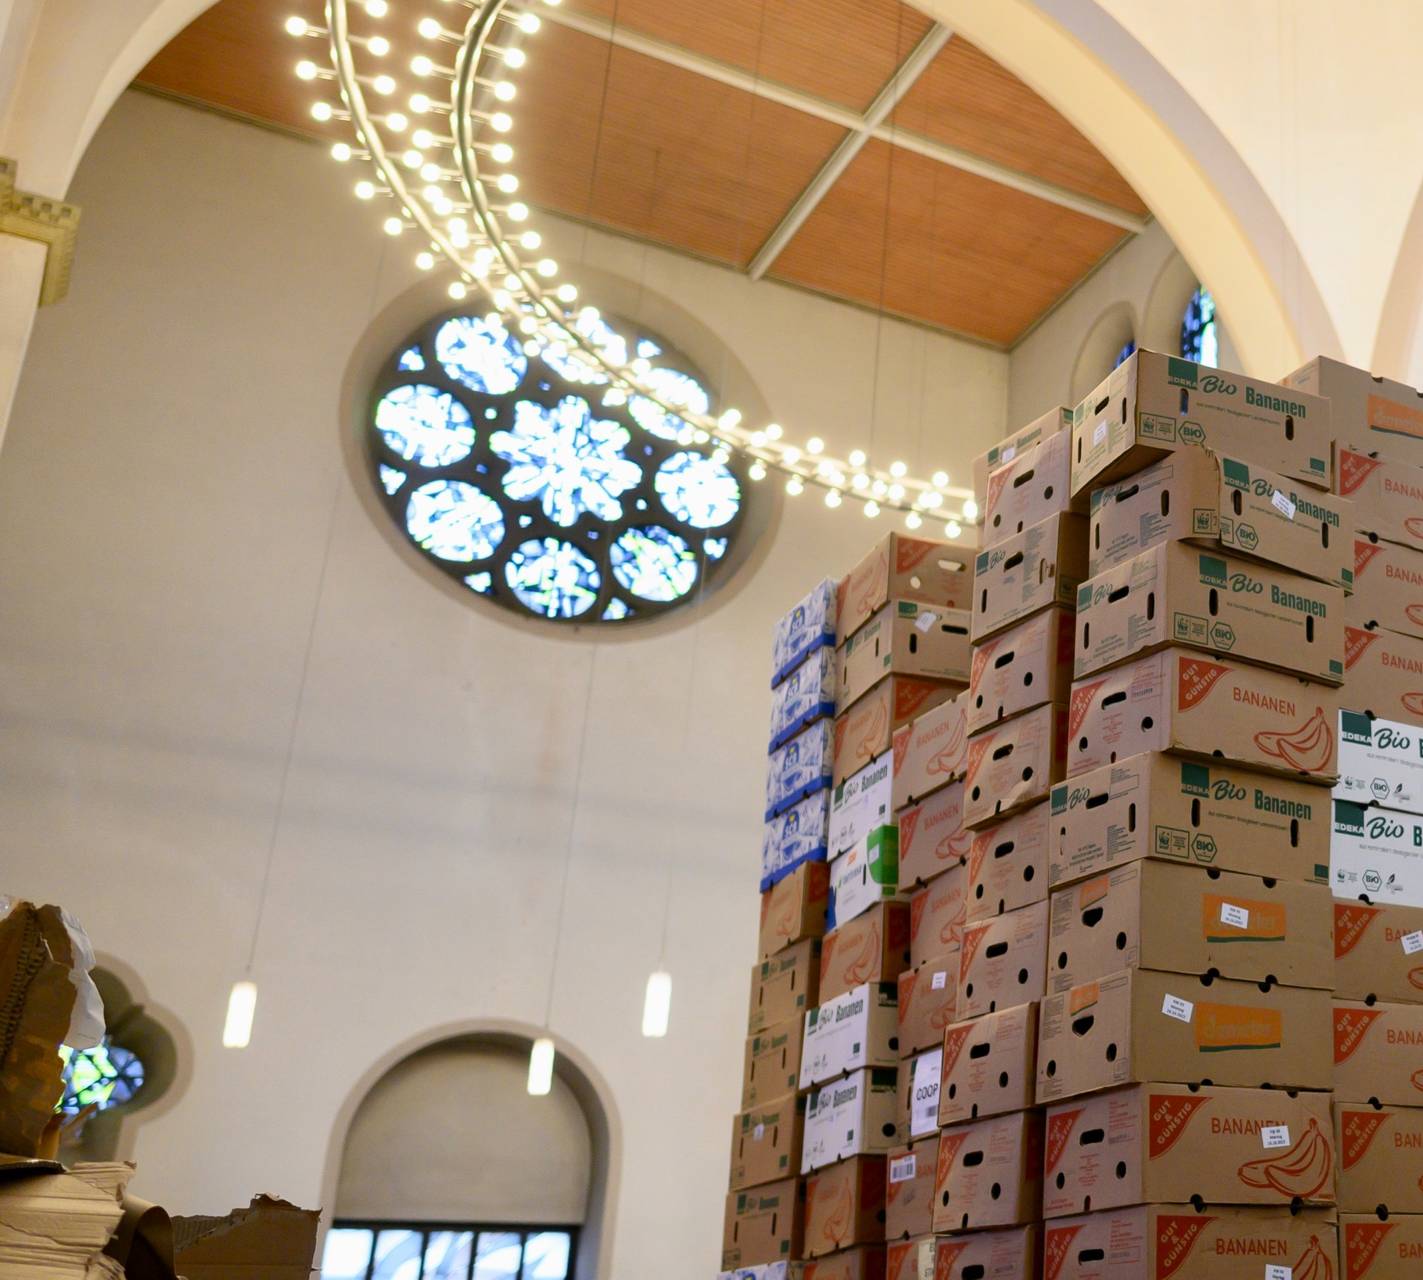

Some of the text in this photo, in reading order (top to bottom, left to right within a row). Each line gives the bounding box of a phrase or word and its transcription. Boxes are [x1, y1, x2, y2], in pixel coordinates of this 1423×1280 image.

[1201, 375, 1238, 396] Bio
[1245, 383, 1306, 419] Bananen
[1183, 427, 1202, 438] BIO
[1290, 492, 1340, 529] Bananen
[1229, 573, 1264, 594] Bio
[1271, 583, 1327, 618] Bananen
[1214, 628, 1232, 641] BIO
[1233, 686, 1296, 717] BANANEN
[1342, 732, 1372, 743] EDEKA
[1374, 728, 1411, 750] Bio
[1373, 783, 1387, 792] BIO
[1211, 779, 1312, 820] Bio Bananen
[1335, 822, 1364, 833] EDEKA
[1366, 816, 1405, 840] Bio
[1196, 840, 1213, 852] BIO
[1365, 875, 1379, 884] BIO
[835, 999, 864, 1023] Bananen
[833, 1085, 858, 1108] Bananen
[916, 1083, 939, 1101] COOP
[1216, 1238, 1287, 1257] BANANEN
